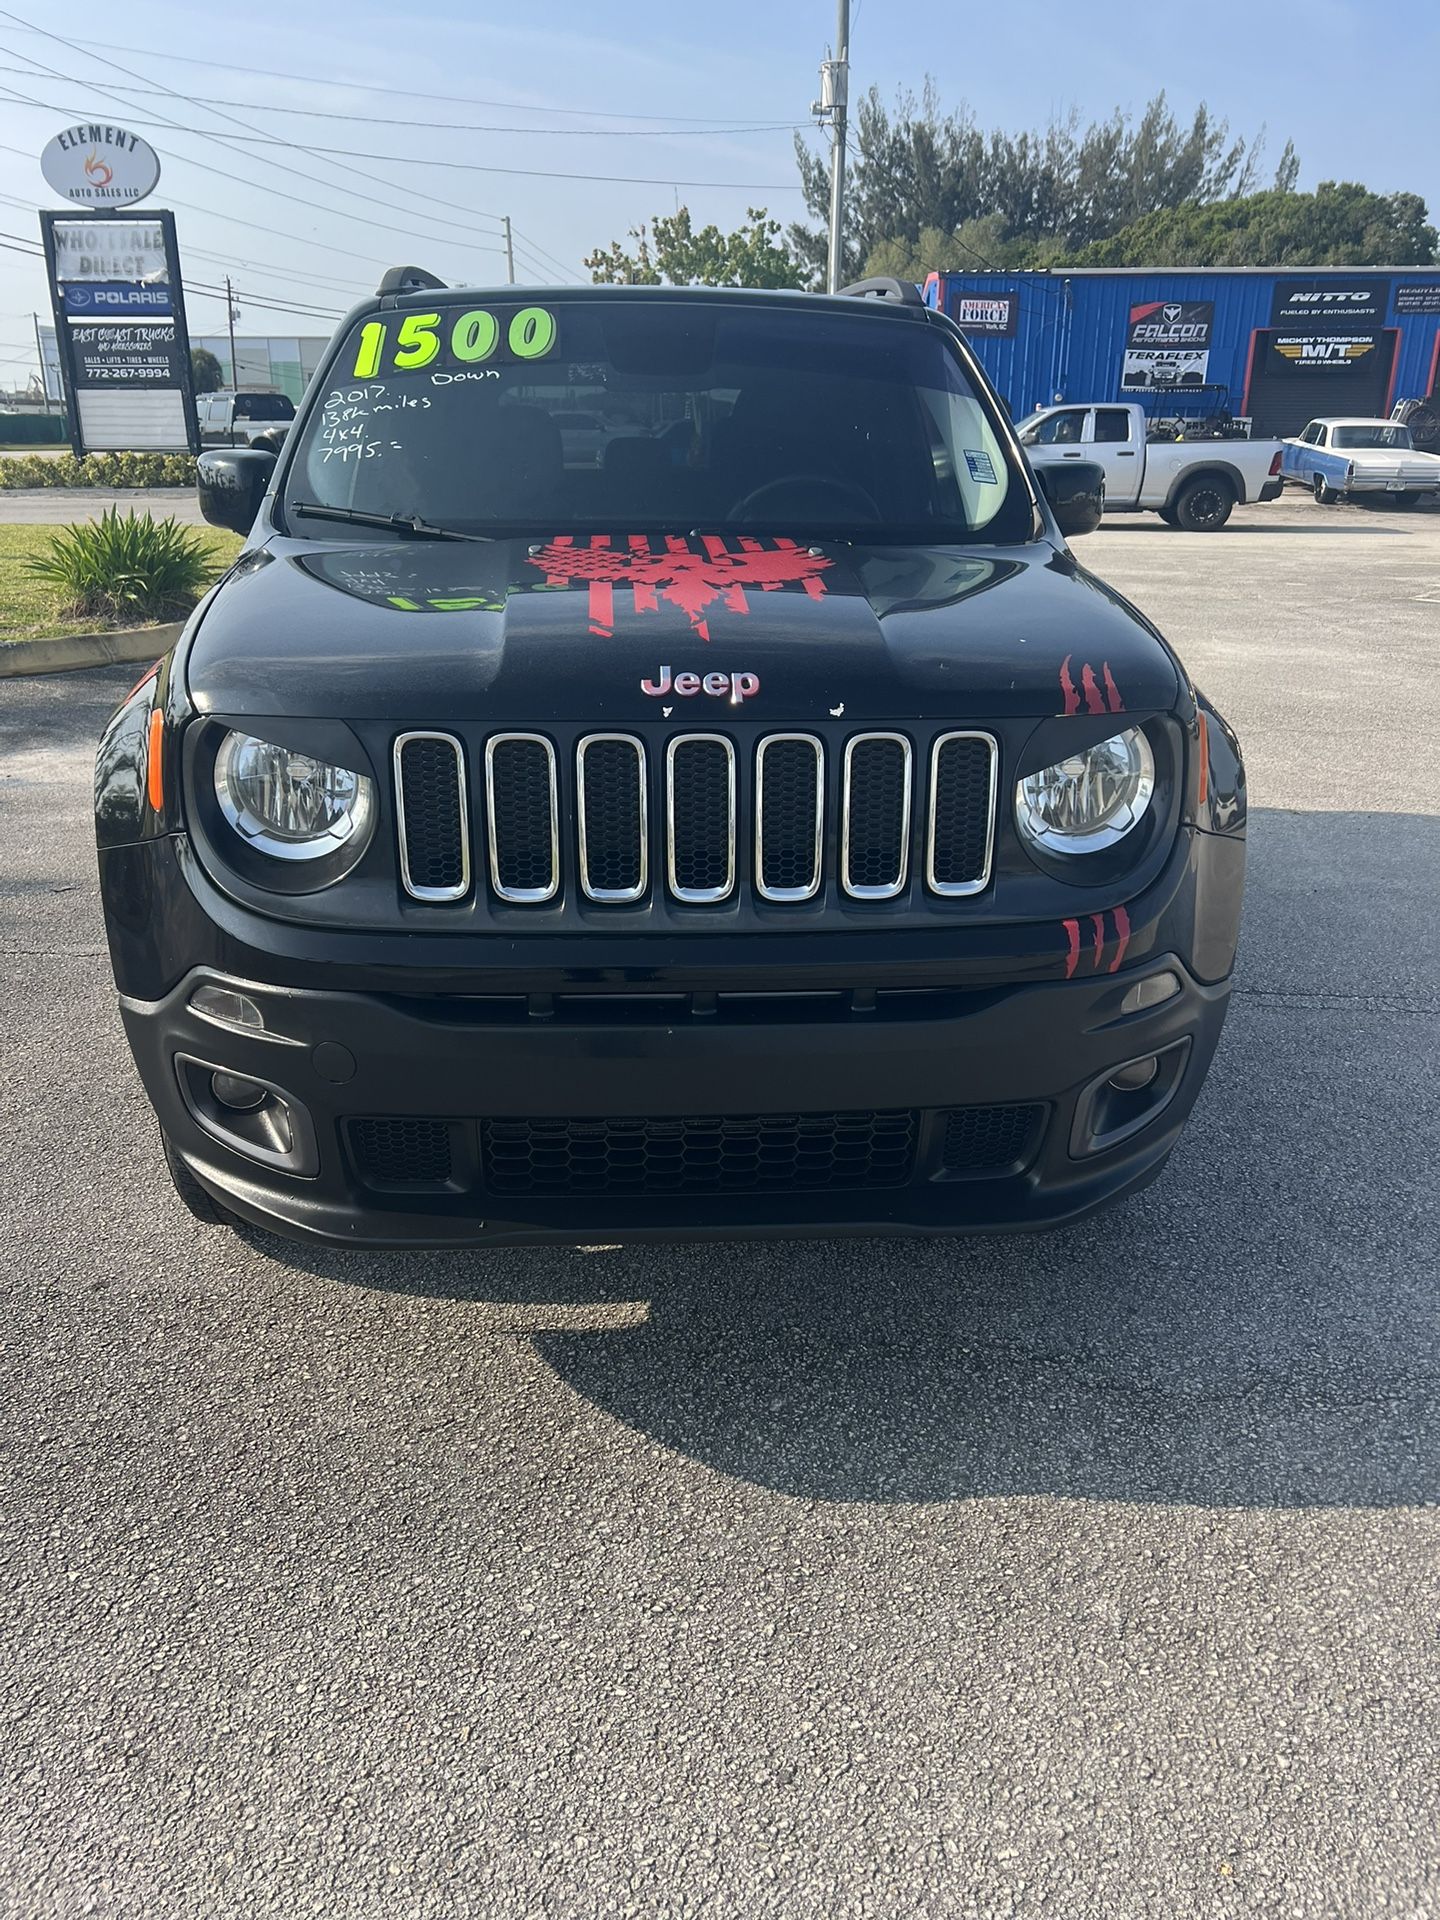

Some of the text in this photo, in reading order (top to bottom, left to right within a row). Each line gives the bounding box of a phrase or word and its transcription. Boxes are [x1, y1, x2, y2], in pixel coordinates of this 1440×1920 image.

[57, 125, 139, 152] ELEMENT
[69, 188, 139, 198] AUTO SALES LLC
[94, 292, 169, 304] POLARIS
[1289, 292, 1371, 302] NITTO
[963, 301, 1007, 309] AMERICAN
[962, 309, 1006, 321] FORCE
[72, 327, 175, 343] EAST COAST TRUCKS
[1133, 324, 1208, 337] FALCON
[353, 307, 557, 379] 1500
[1128, 352, 1204, 360] TERAFLEX
[1302, 343, 1352, 358] M/T
[84, 356, 101, 364] SALES
[86, 368, 170, 378] 772-267-9994
[431, 369, 500, 386] Down
[373, 395, 432, 413] miles
[640, 665, 760, 704] Jeep
